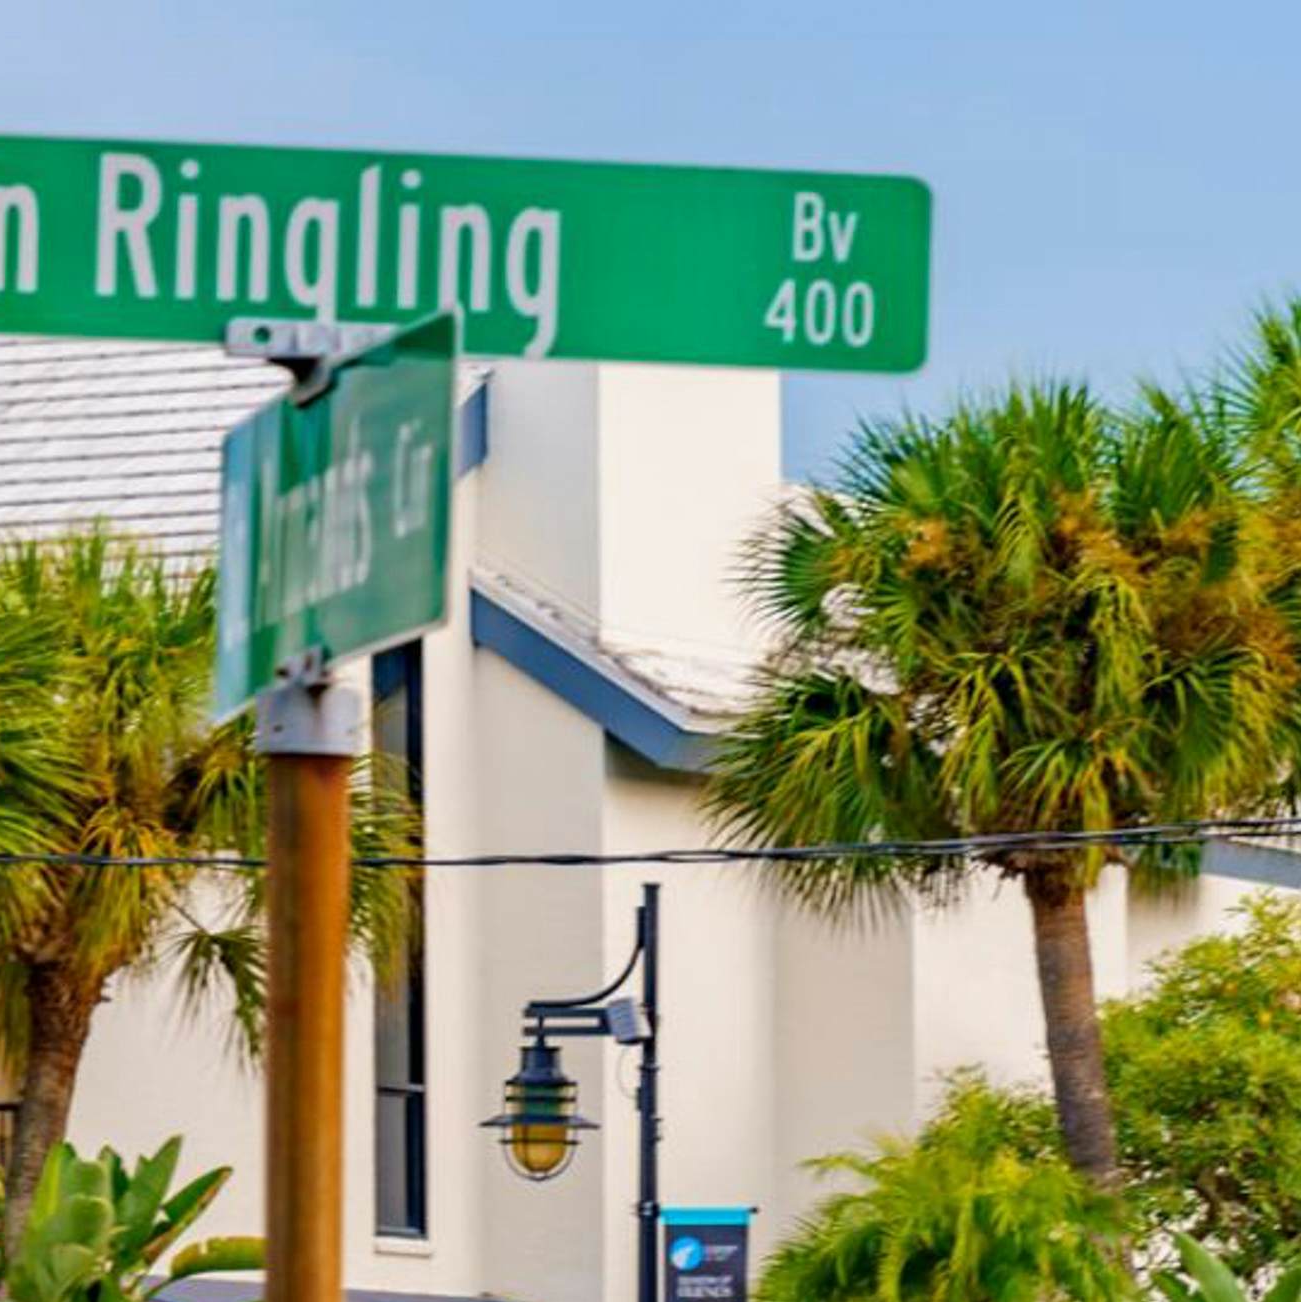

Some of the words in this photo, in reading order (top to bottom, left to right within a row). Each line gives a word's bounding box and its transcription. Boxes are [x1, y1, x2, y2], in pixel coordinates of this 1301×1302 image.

[96, 153, 562, 359] Ringling
[793, 191, 860, 265] Bv
[765, 280, 876, 348] 400
